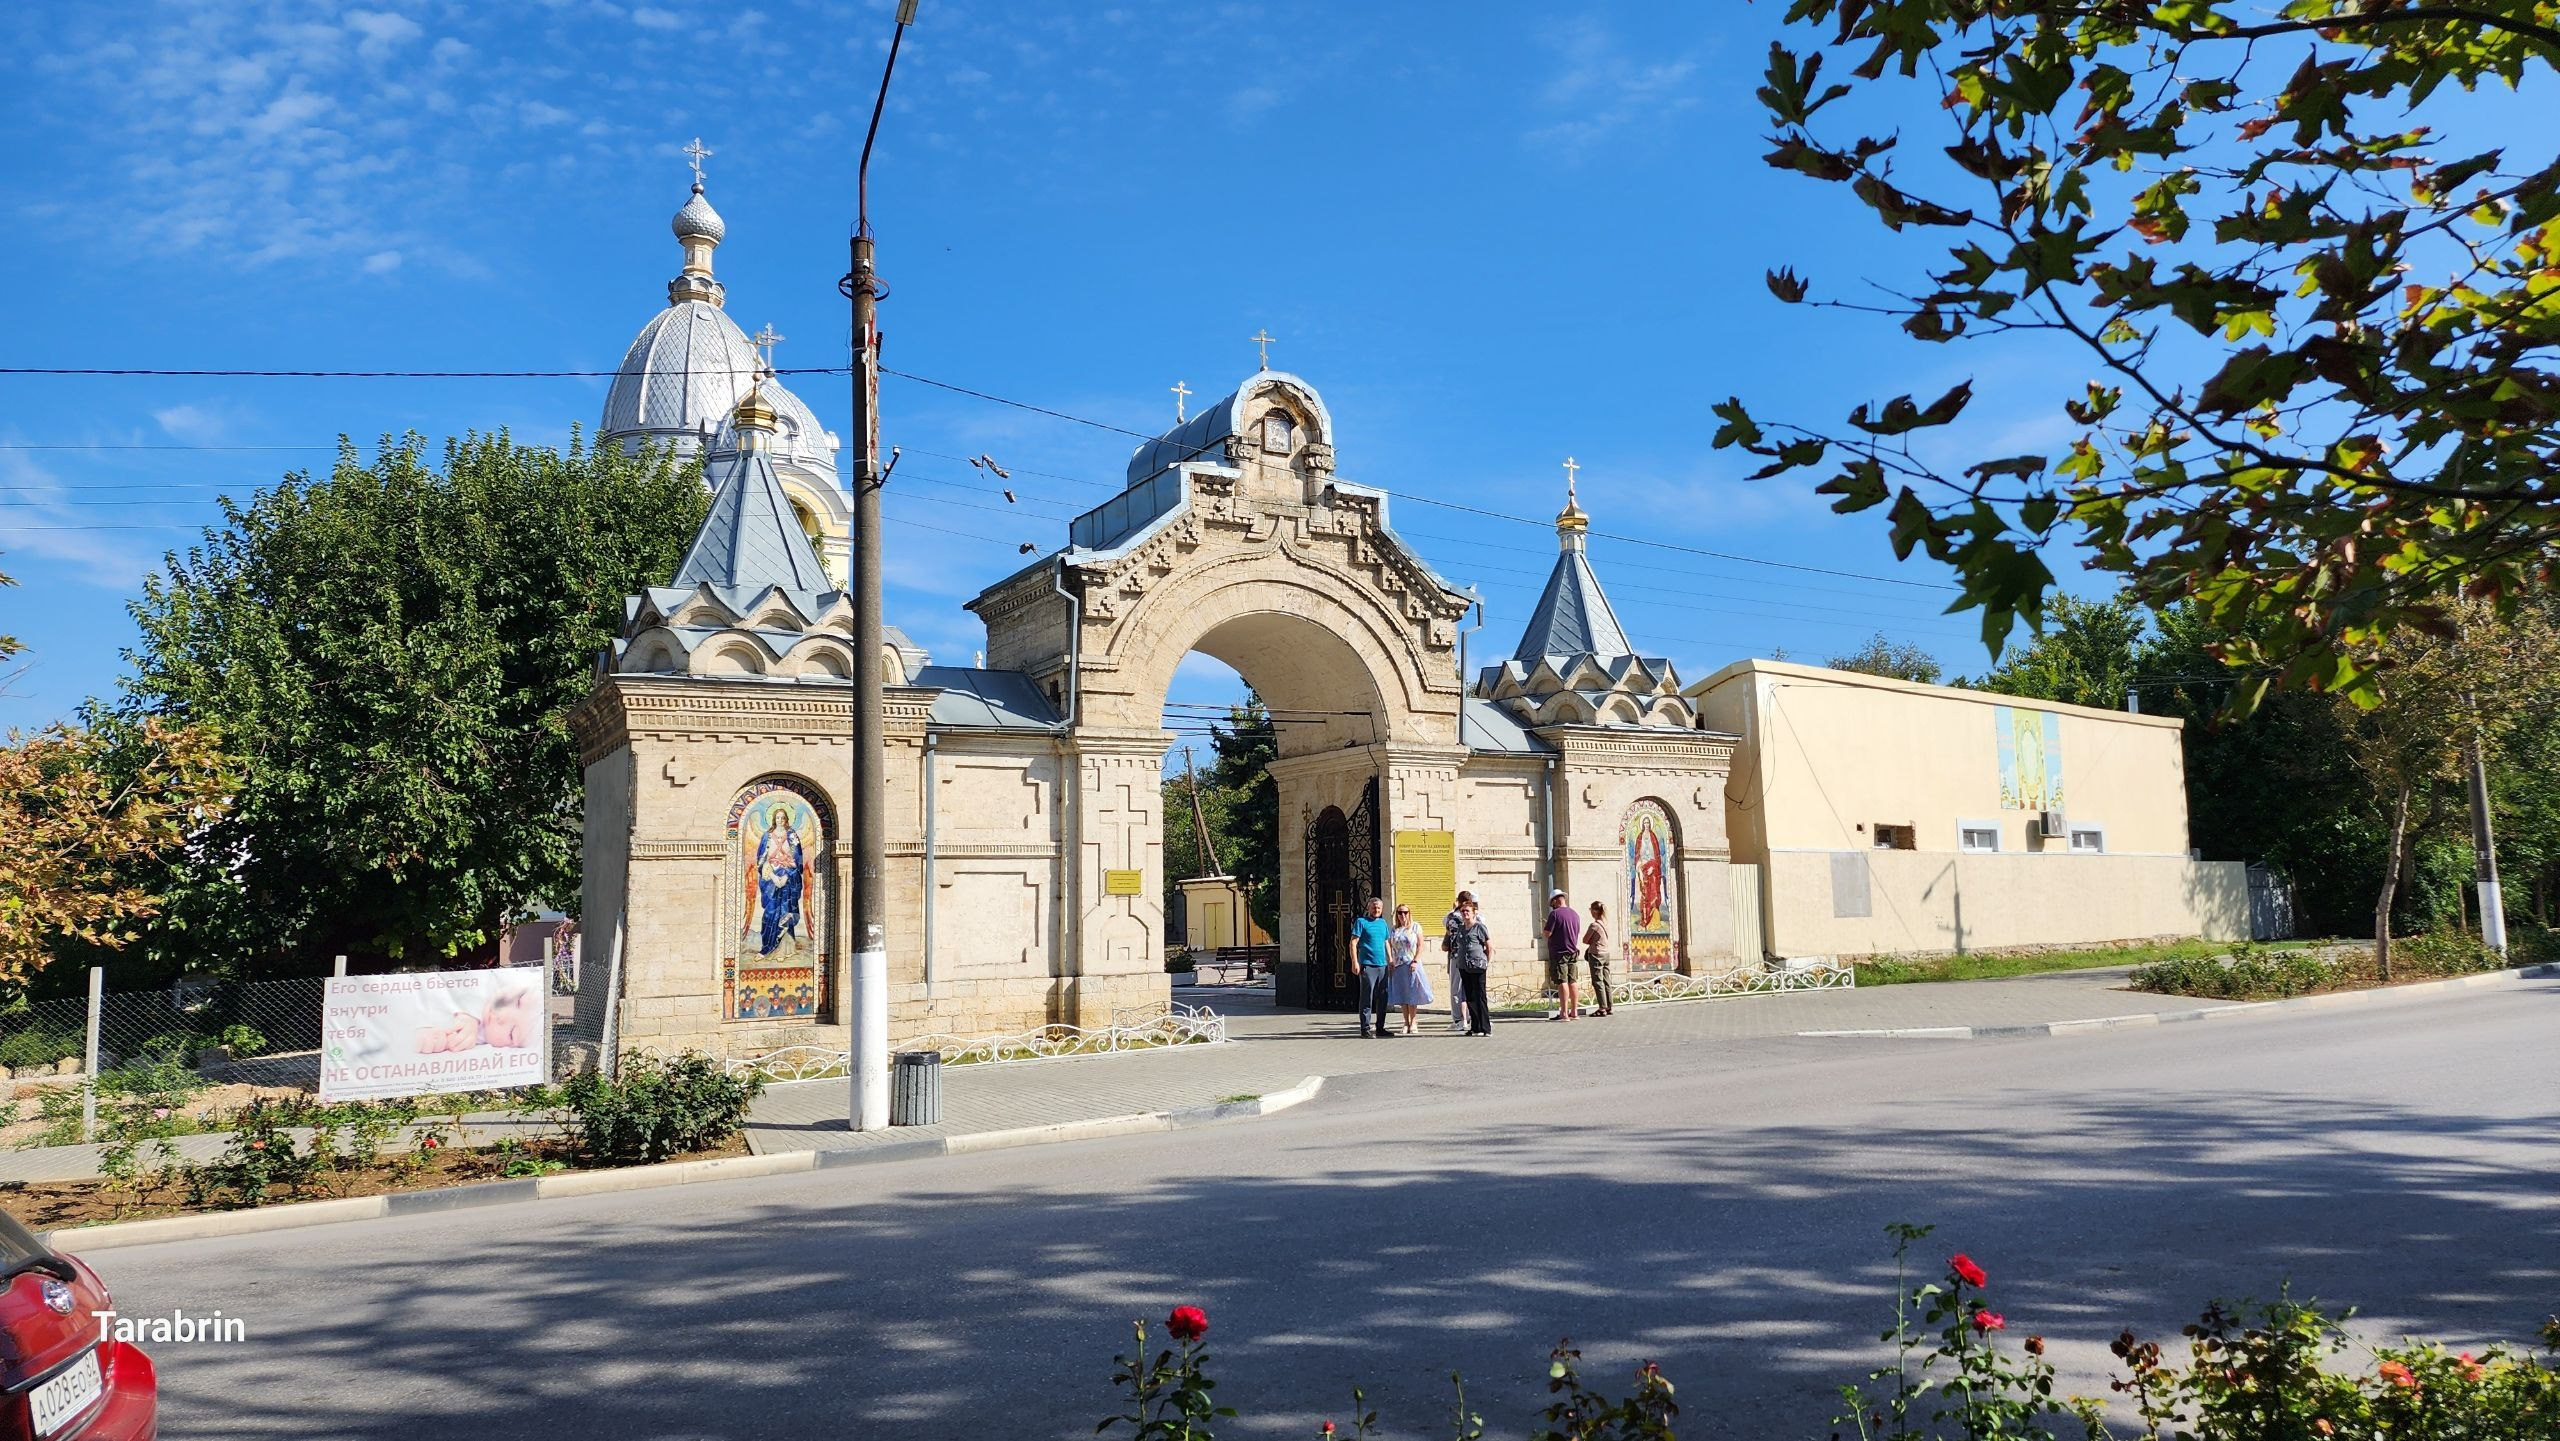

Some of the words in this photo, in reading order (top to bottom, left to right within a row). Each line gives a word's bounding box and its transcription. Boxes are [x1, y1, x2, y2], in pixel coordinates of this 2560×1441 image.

[331, 982, 357, 994] Его
[362, 980, 422, 995] сердце
[427, 977, 479, 990] бьется
[330, 1004, 389, 1018] внутри
[328, 1026, 366, 1040] тебя
[326, 1067, 350, 1082] НЕ
[355, 1055, 503, 1081] ОСТАНАВЛИВАЙ
[509, 1052, 540, 1068] ЕГО
